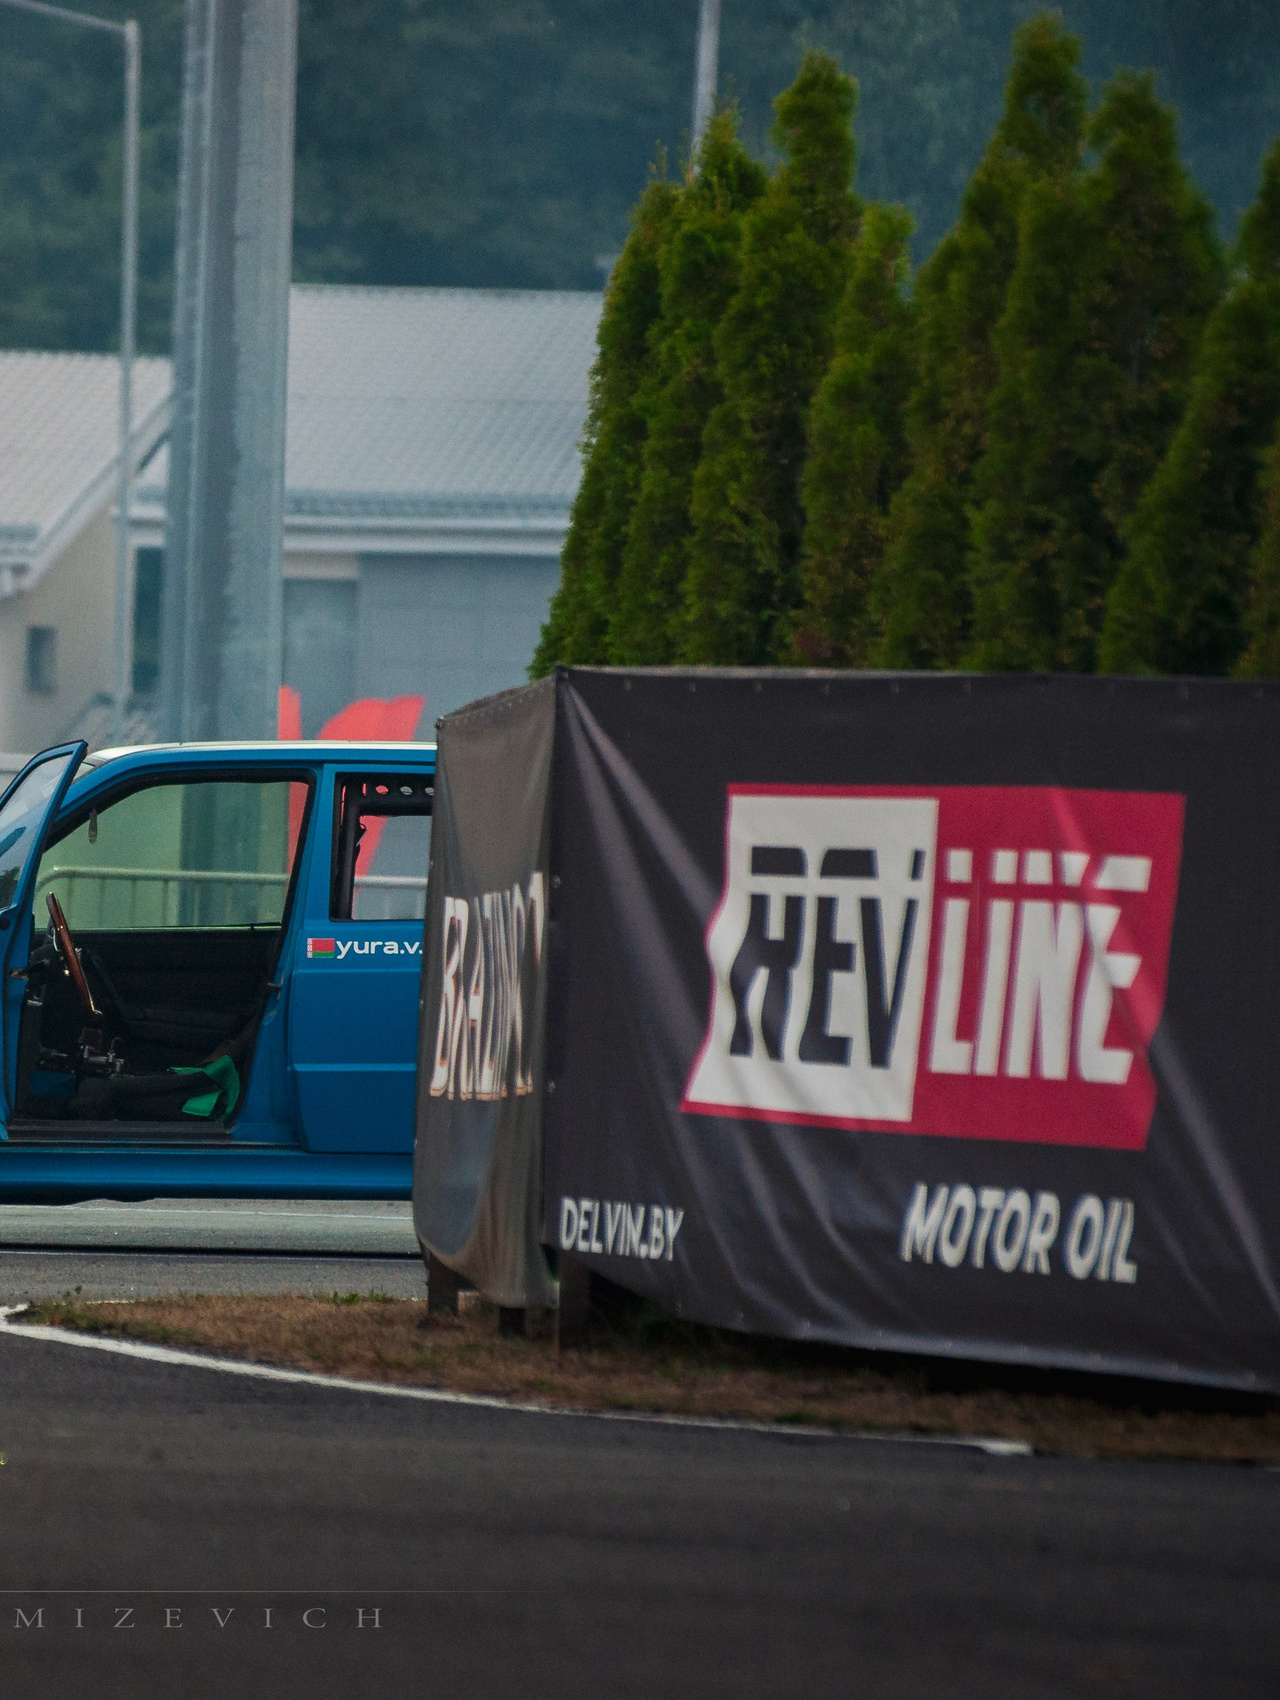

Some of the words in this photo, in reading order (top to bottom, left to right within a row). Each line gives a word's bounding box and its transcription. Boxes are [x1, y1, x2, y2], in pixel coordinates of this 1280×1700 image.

[559, 1196, 685, 1262] DELVIN.BY
[900, 1182, 1060, 1276] MOTOR
[1065, 1193, 1138, 1285] OIL
